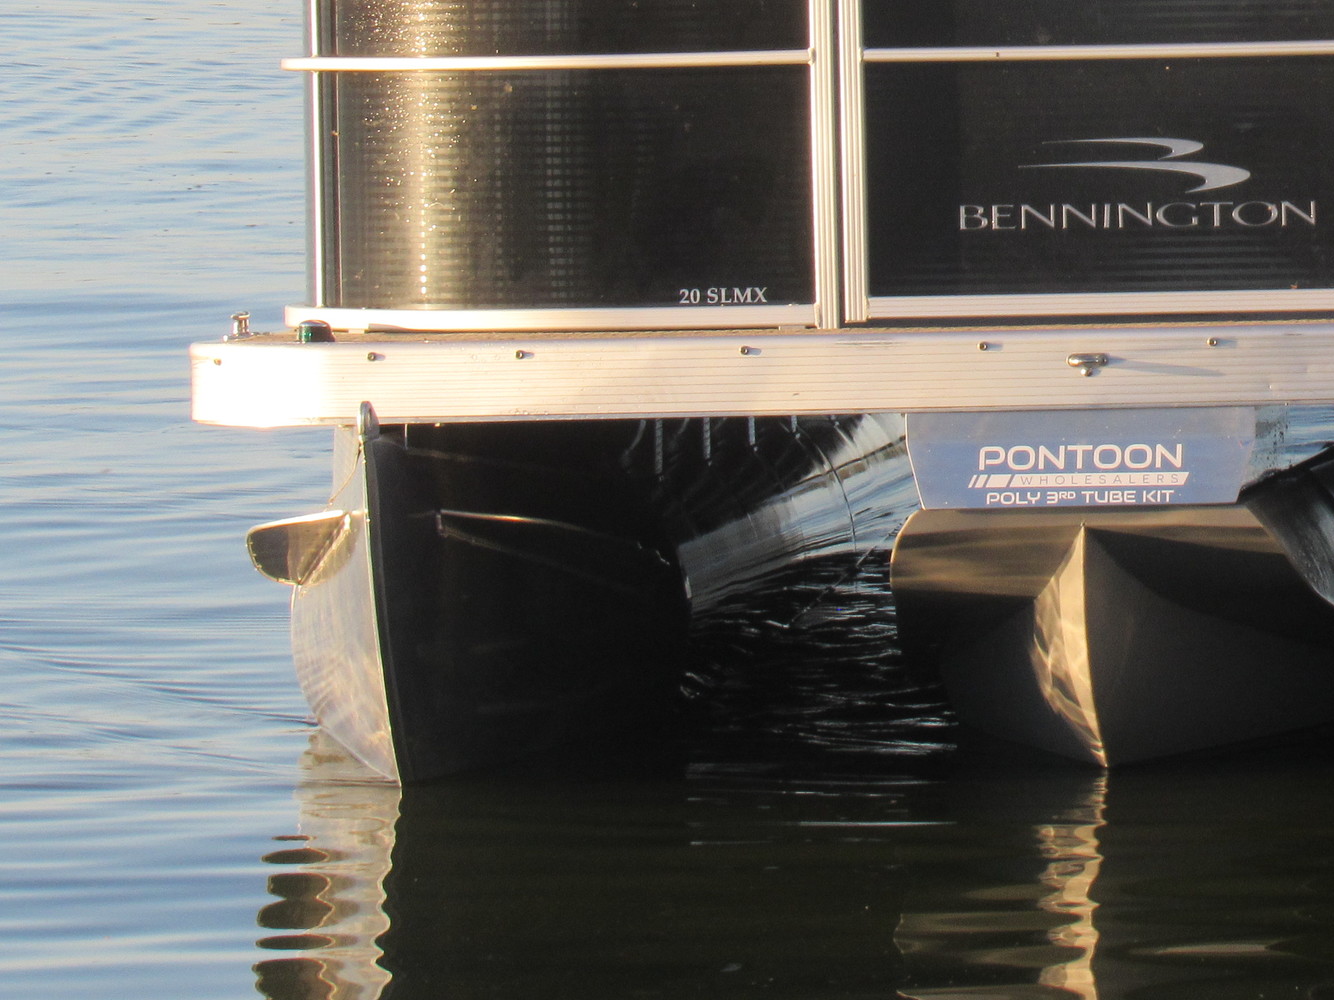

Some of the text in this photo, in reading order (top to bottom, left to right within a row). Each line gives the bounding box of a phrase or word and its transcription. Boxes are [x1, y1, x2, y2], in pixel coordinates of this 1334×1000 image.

[959, 201, 1317, 230] BENNINGTON
[679, 286, 768, 304] 20 SLMX
[978, 443, 1184, 471] PONTOON
[1020, 472, 1181, 486] WHOLESALERS
[986, 489, 1175, 505] POLY 3RD TUBE KIT
